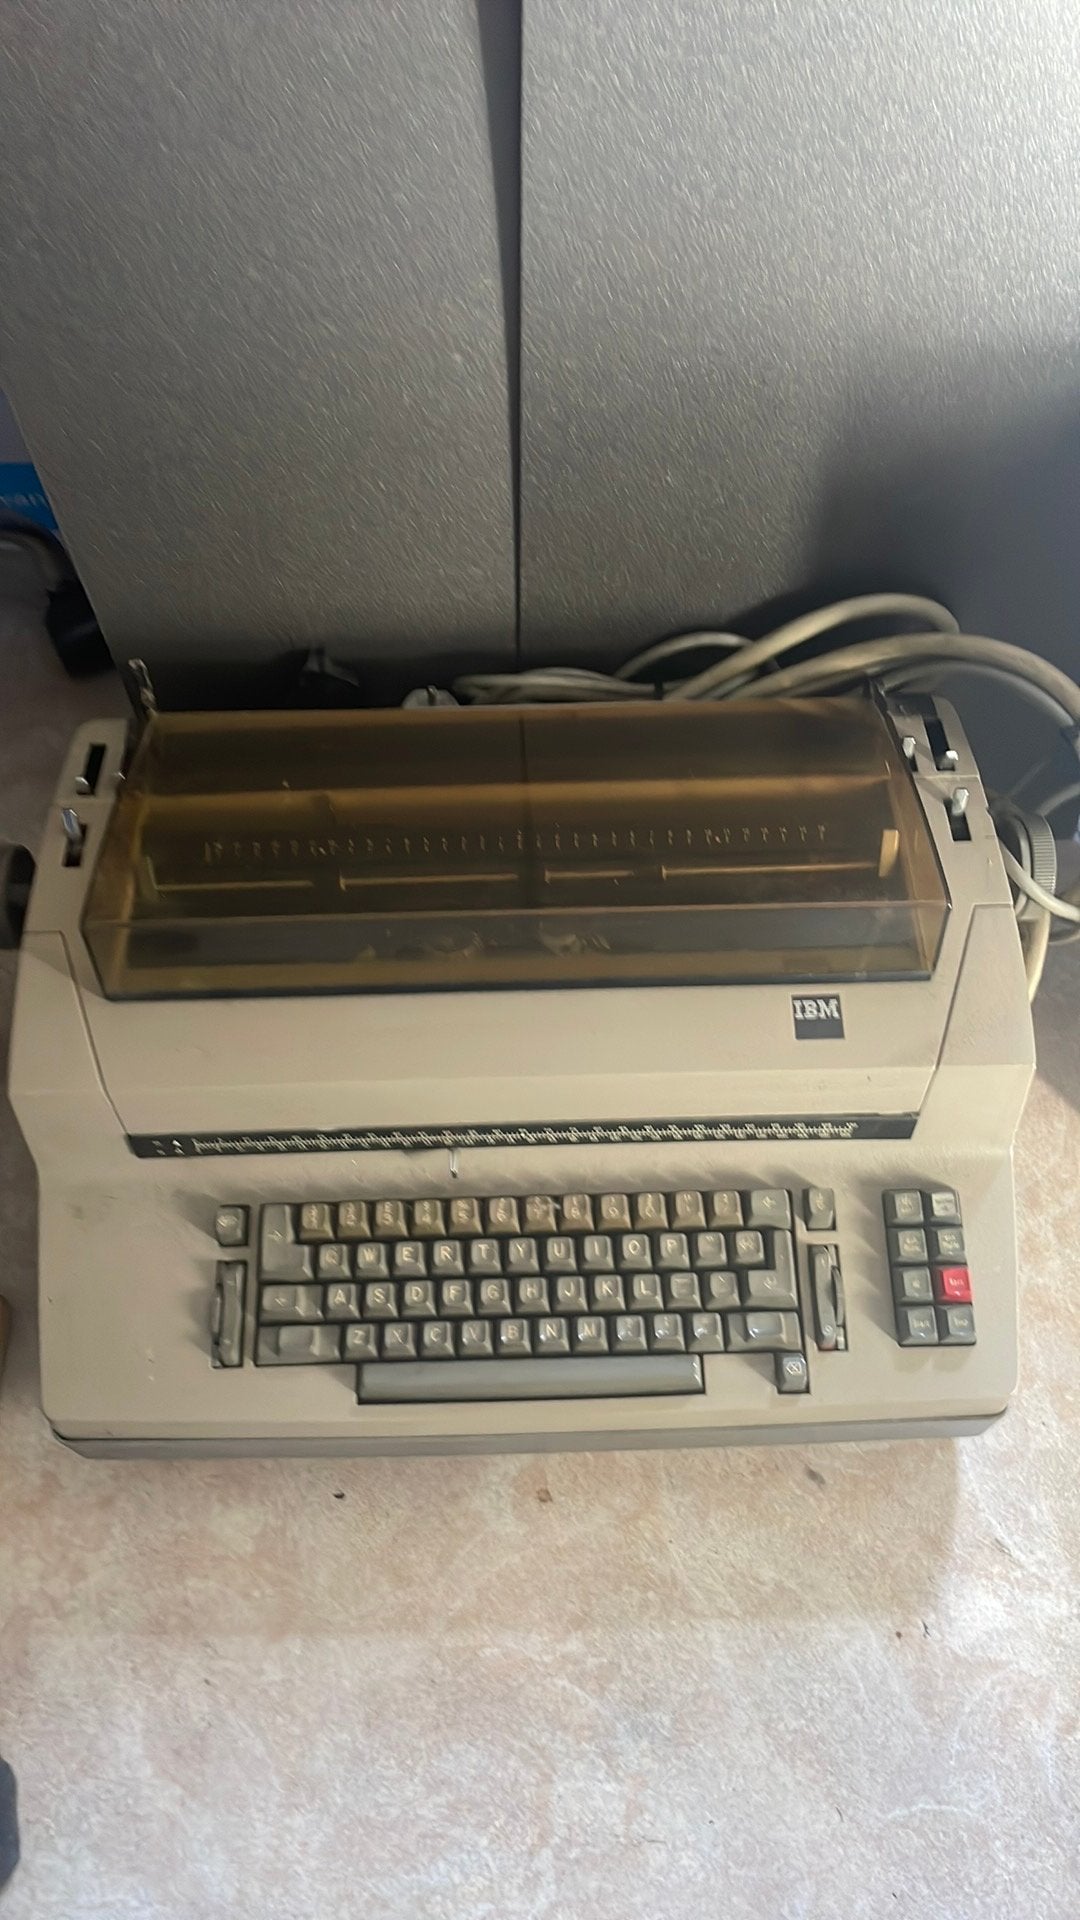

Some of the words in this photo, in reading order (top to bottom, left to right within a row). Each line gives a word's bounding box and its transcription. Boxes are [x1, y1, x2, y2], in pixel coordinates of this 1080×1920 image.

[793, 999, 840, 1020] IBM
[363, 1248, 376, 1262] W
[402, 1246, 415, 1263] E
[440, 1246, 453, 1262] R
[478, 1243, 490, 1260] T
[516, 1243, 527, 1258] Y
[553, 1243, 565, 1258] U
[628, 1239, 641, 1255] O
[666, 1239, 678, 1255] P
[334, 1285, 346, 1304] A
[373, 1287, 386, 1304] S
[411, 1286, 423, 1301] D
[449, 1285, 461, 1301] F
[487, 1284, 499, 1300] G
[526, 1283, 538, 1299] H
[564, 1282, 574, 1298] J
[602, 1280, 614, 1297] K
[640, 1279, 652, 1296] L
[353, 1329, 366, 1345] Z
[430, 1327, 441, 1343] C
[507, 1325, 519, 1340] B
[545, 1323, 558, 1339] N
